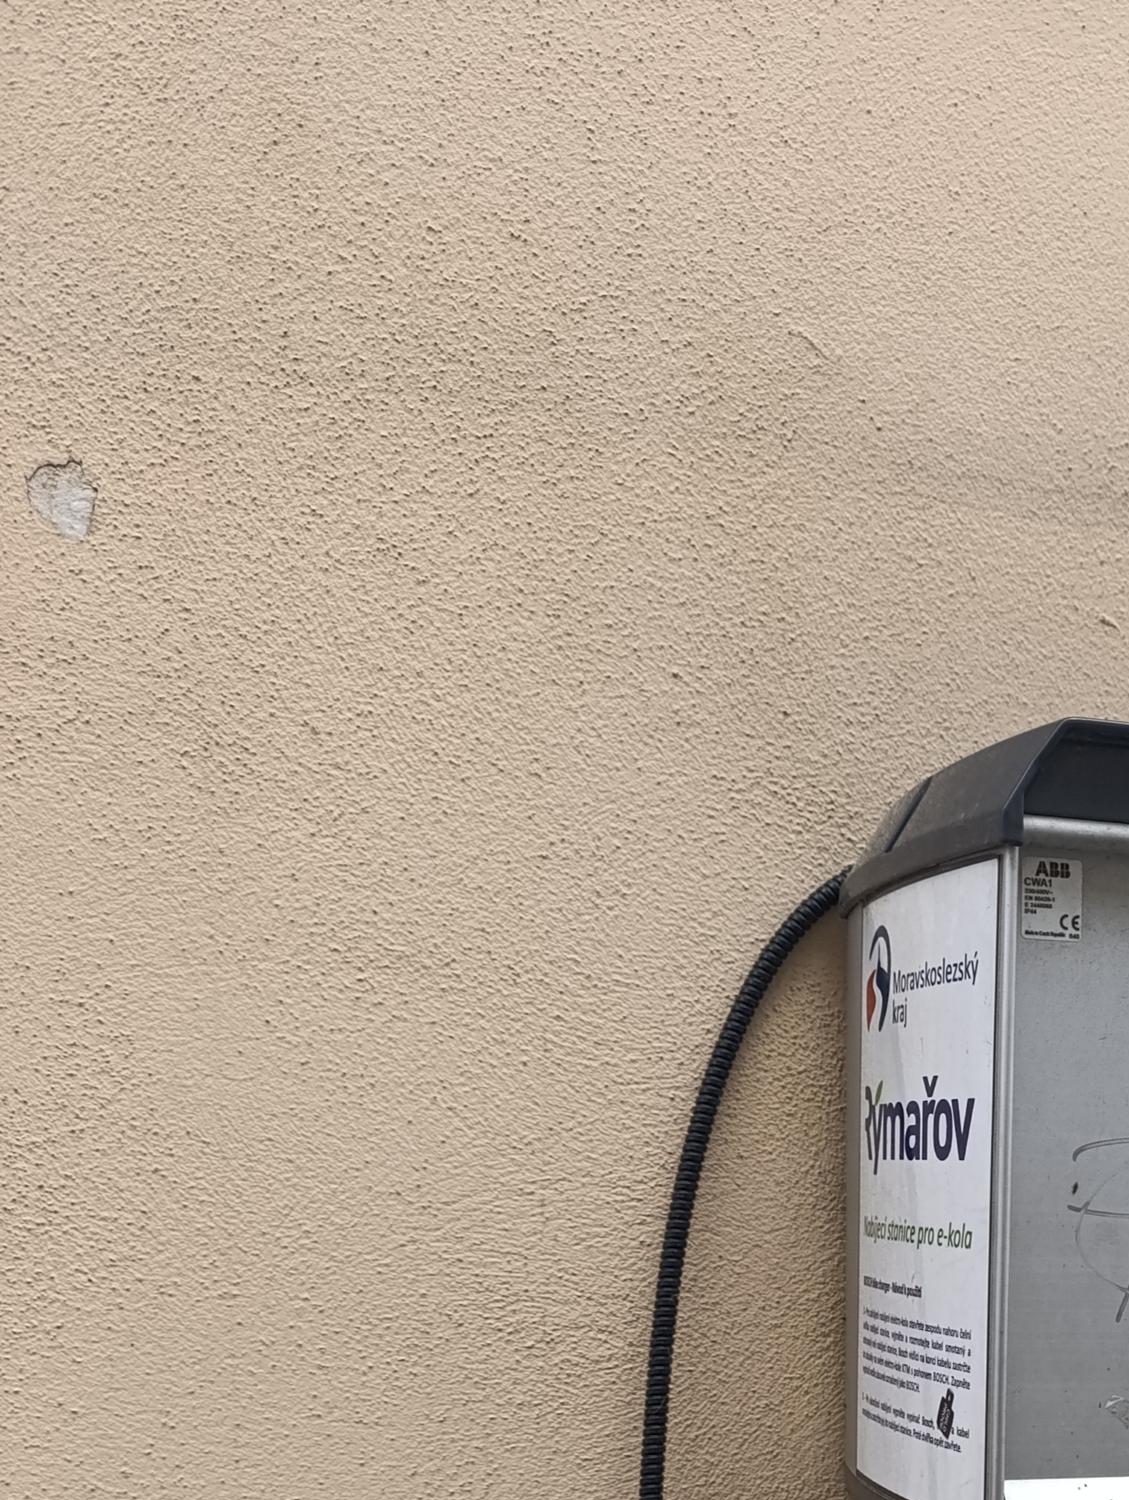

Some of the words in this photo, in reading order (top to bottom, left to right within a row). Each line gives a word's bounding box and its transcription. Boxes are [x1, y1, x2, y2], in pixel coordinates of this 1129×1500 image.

[1024, 877, 1053, 887] CWA1
[1035, 861, 1071, 879] ABB
[892, 951, 979, 994] Moravskoslezský
[892, 998, 908, 1028] kraj
[865, 1075, 975, 1175] Rýmařov
[887, 1218, 916, 1244] stanice
[916, 1226, 935, 1250] pro
[936, 1221, 973, 1250] e-kola
